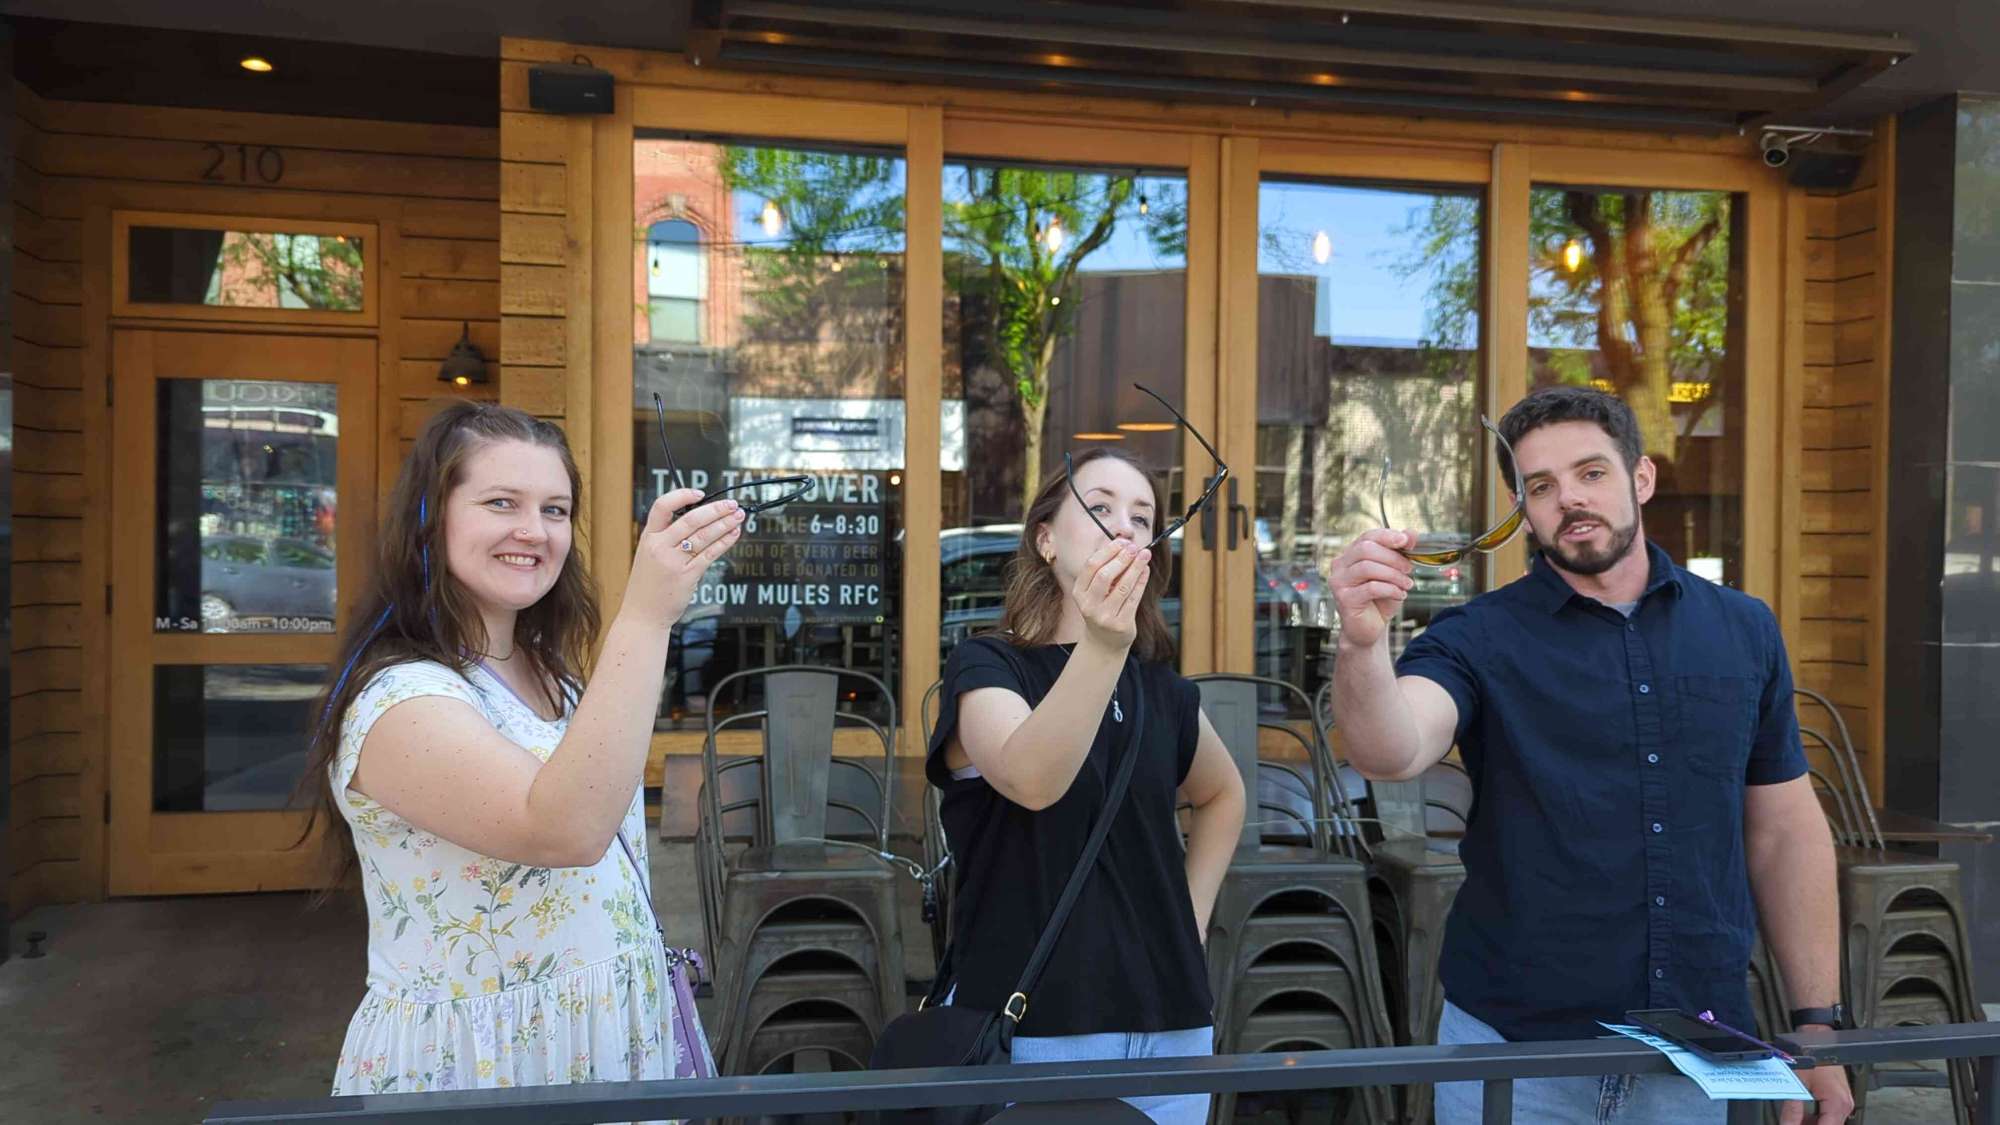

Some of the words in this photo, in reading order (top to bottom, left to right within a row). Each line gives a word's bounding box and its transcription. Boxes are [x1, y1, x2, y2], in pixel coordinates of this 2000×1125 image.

[201, 142, 284, 184] 210
[770, 544, 786, 559] OF
[794, 544, 839, 560] EVERY
[843, 545, 879, 560] BEER
[734, 562, 767, 578] WILL
[773, 562, 790, 578] BE
[796, 562, 857, 578] DONATED
[864, 563, 879, 578] TO
[758, 584, 830, 606] MULES
[840, 584, 879, 606] RFC
[155, 617, 170, 630] M
[179, 617, 198, 630] Sa
[272, 617, 332, 632] 10:00pm
